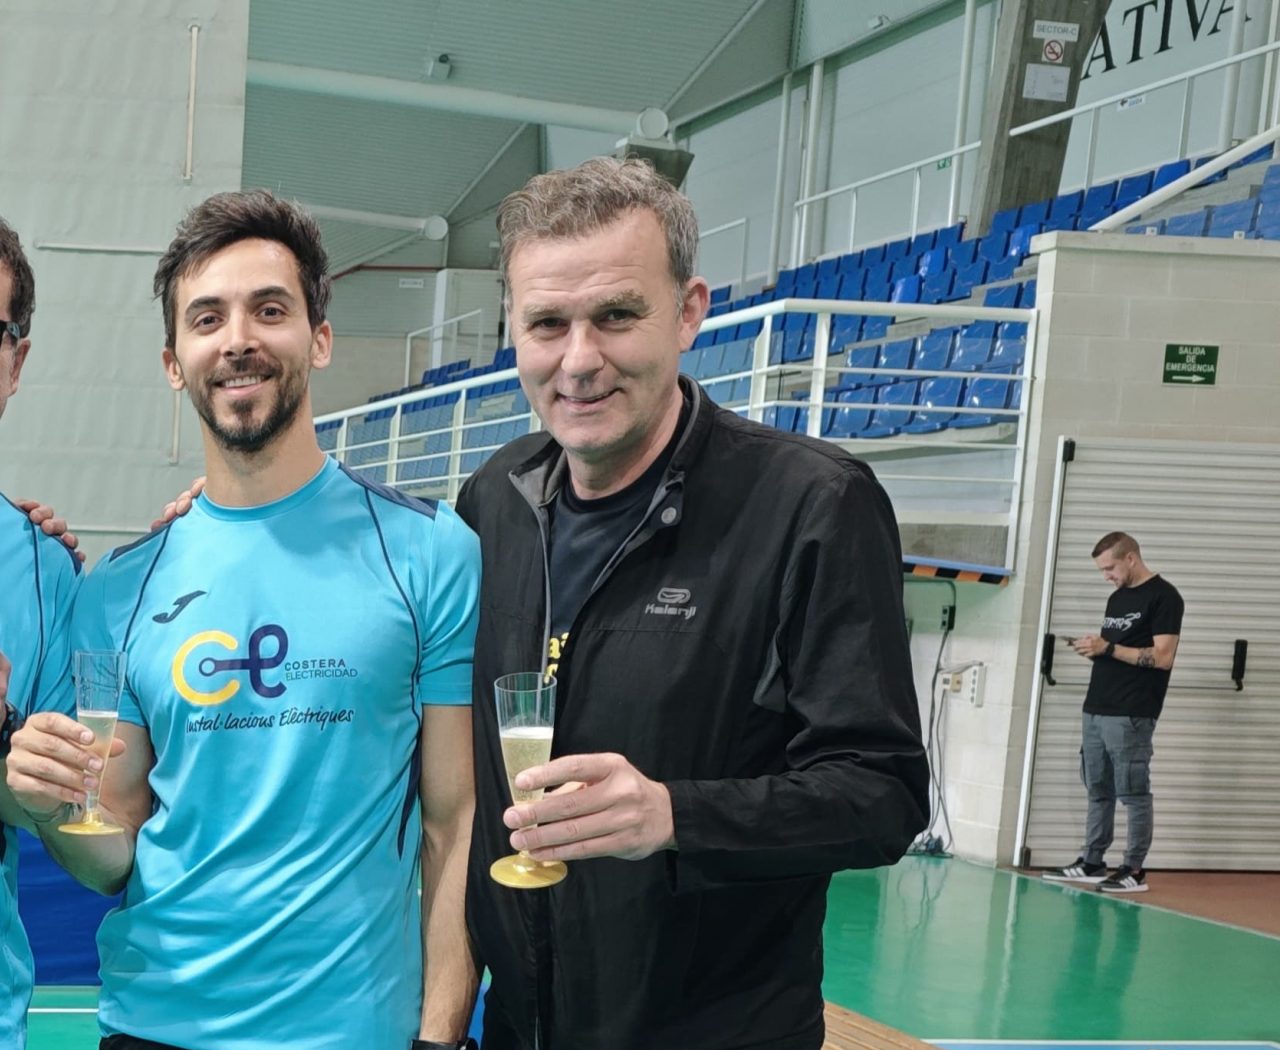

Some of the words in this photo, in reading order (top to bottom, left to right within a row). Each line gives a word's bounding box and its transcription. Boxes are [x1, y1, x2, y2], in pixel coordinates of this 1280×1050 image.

[1178, 346, 1206, 356] SALIDA
[1186, 355, 1197, 363] DE
[1165, 362, 1215, 372] EMERGENCIA
[284, 659, 346, 671] COSTERA
[286, 669, 358, 681] ELECTRICIDAD
